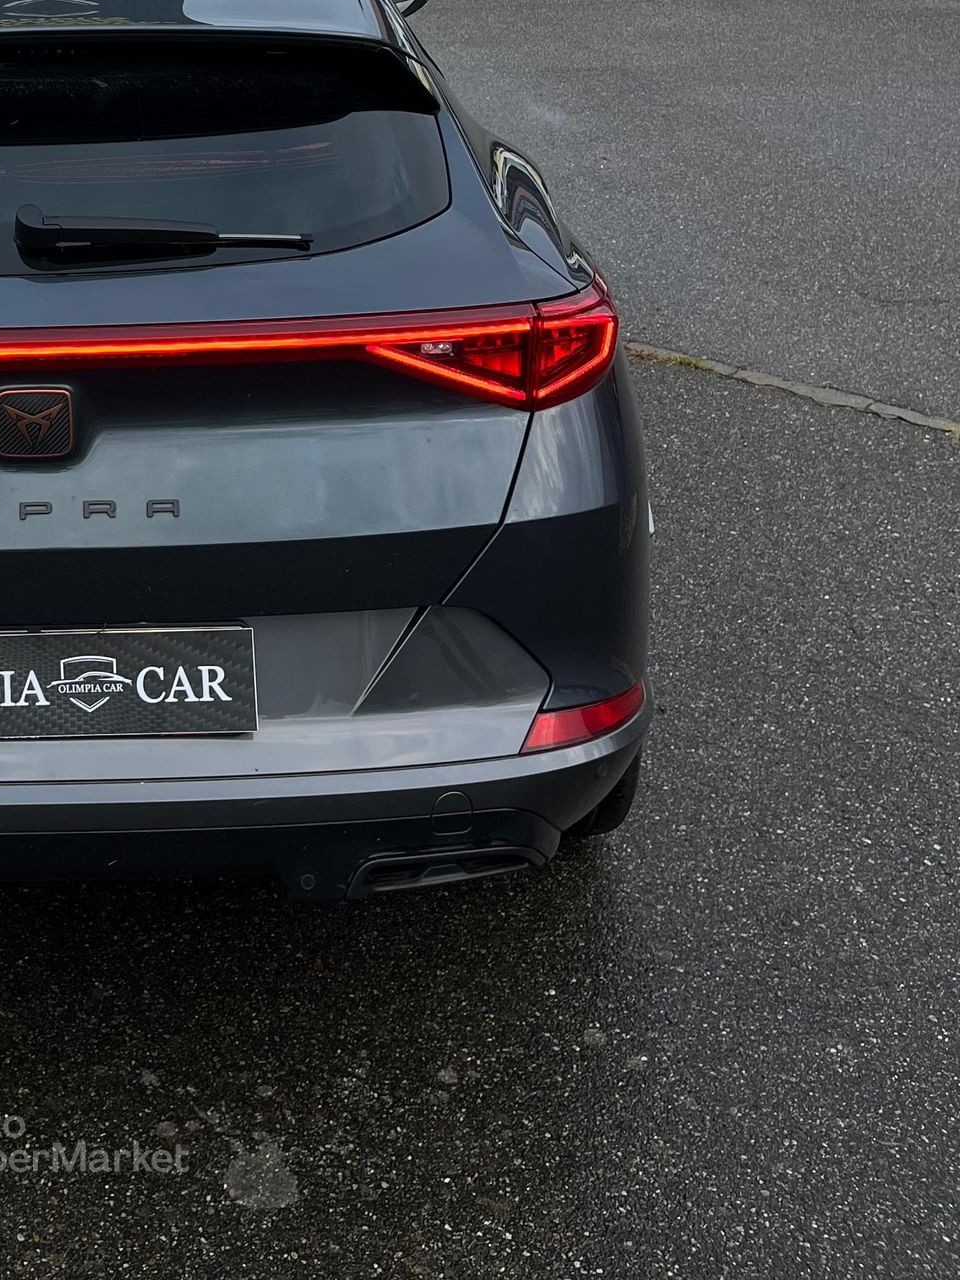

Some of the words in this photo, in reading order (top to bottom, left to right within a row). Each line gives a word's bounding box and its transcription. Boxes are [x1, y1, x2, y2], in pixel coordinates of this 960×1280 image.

[58, 684, 102, 694] OLIMPIA
[103, 682, 124, 693] CAR
[136, 665, 232, 704] CAR
